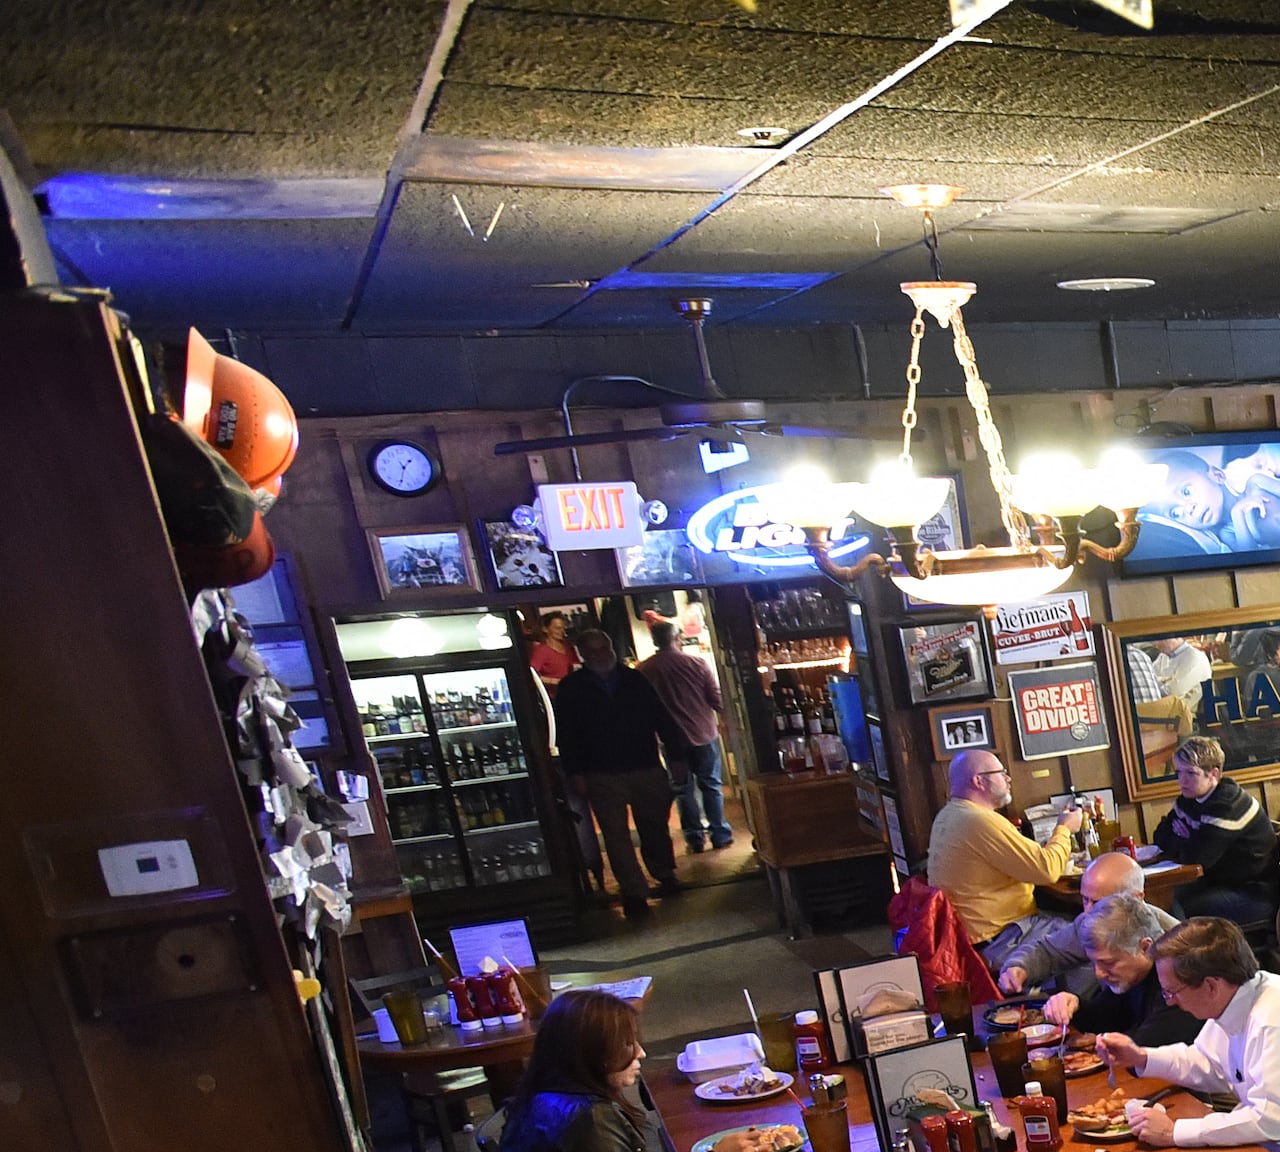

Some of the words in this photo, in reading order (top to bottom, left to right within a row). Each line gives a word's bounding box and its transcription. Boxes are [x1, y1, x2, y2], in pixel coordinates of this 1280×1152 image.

[558, 487, 626, 532] EXIT
[715, 517, 856, 551] LIGT
[997, 604, 1068, 634] Liefmans
[1022, 682, 1085, 711] GREAT
[1025, 704, 1090, 732] DIVIDE
